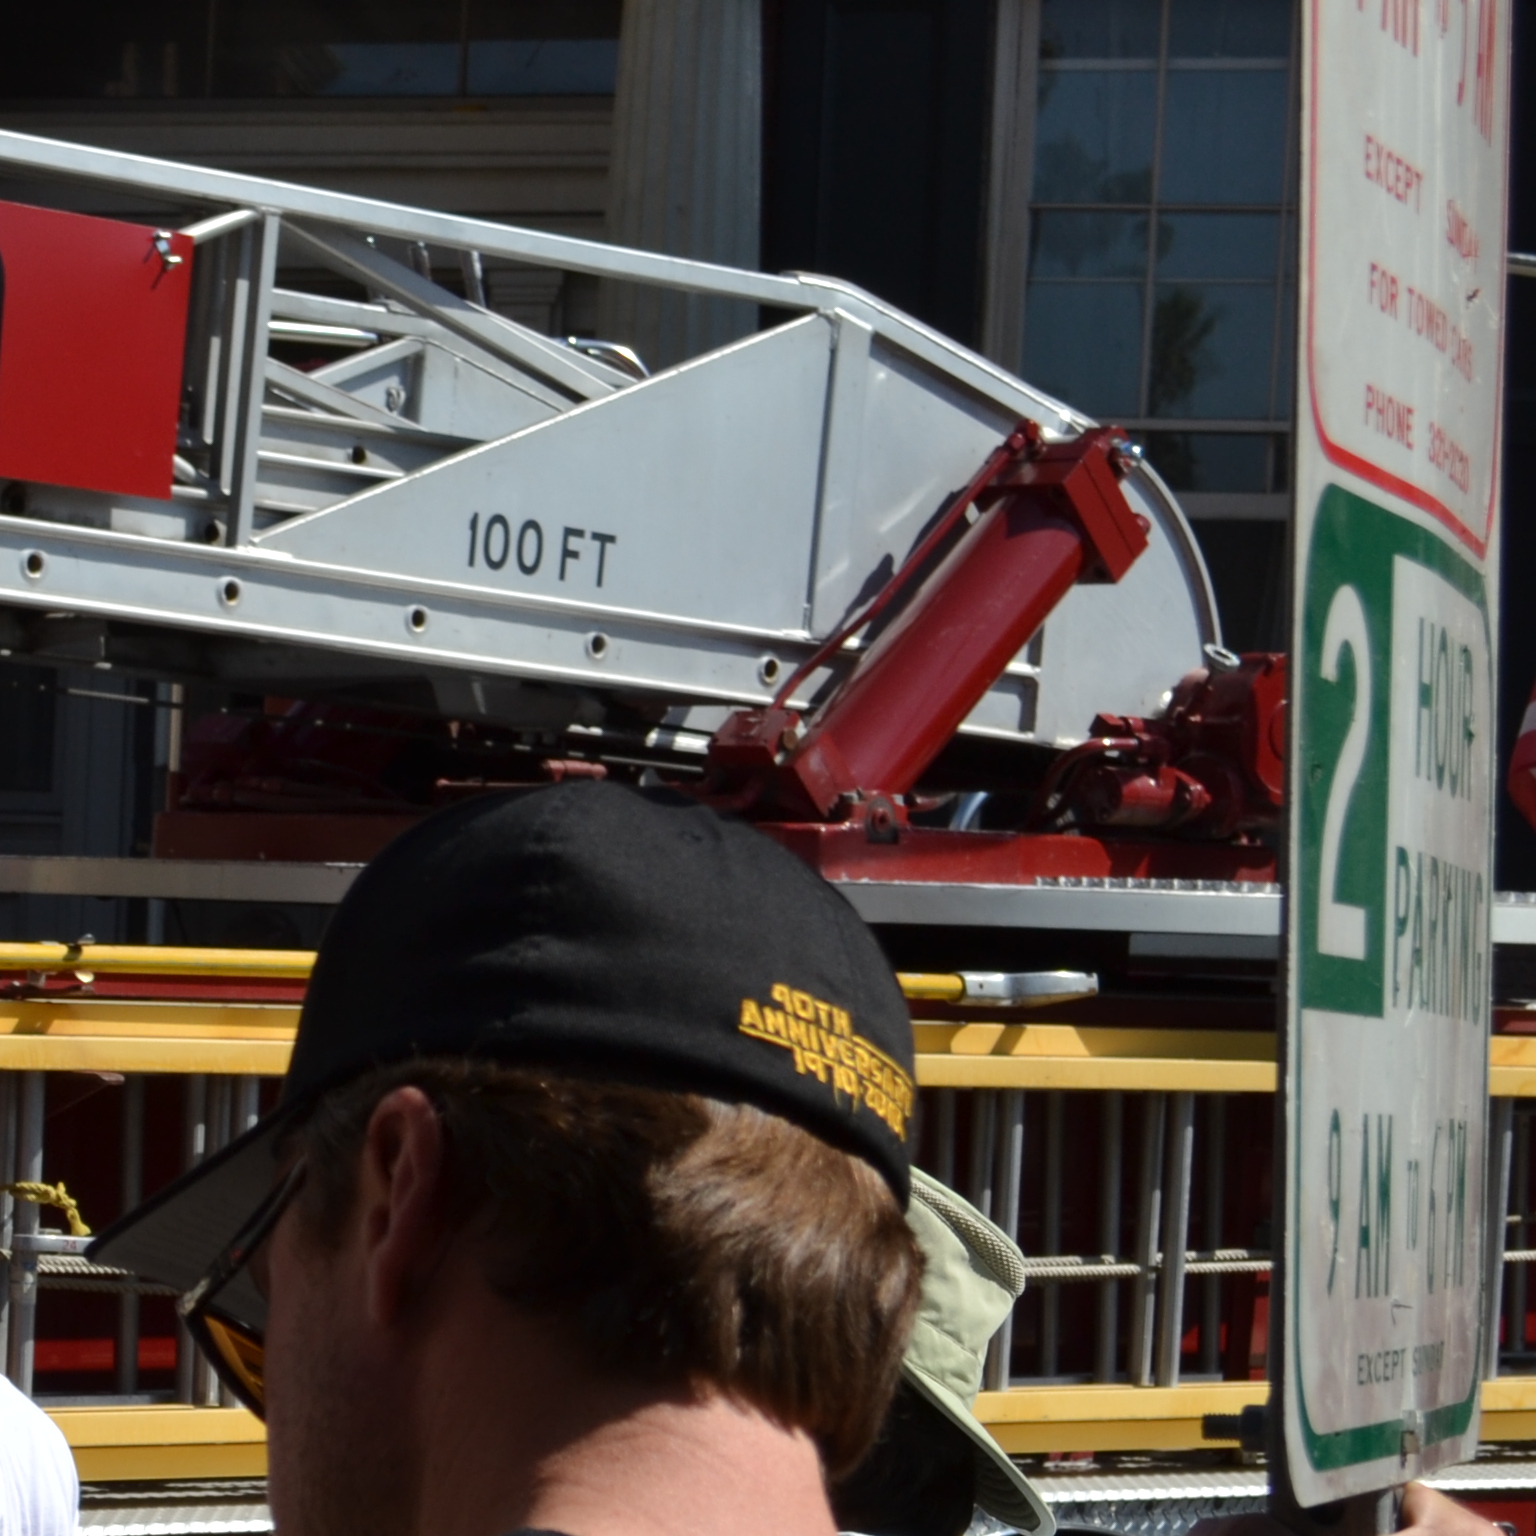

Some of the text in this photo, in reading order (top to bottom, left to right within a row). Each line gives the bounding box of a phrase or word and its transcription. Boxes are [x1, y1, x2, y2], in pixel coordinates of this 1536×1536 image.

[1365, 134, 1423, 216] EXCEPT
[1370, 262, 1398, 321] FOR
[1407, 287, 1448, 353] TOWED
[1364, 383, 1413, 450] PHONE
[468, 512, 617, 588] 100 FT
[1415, 616, 1475, 802] HOUR
[1319, 583, 1372, 961] 2
[1392, 845, 1484, 1027] PARKING
[771, 982, 852, 1040] 90TH
[1327, 1107, 1467, 1300] 9 AM TO 6 PM
[1357, 1347, 1406, 1386] EXCEPT
